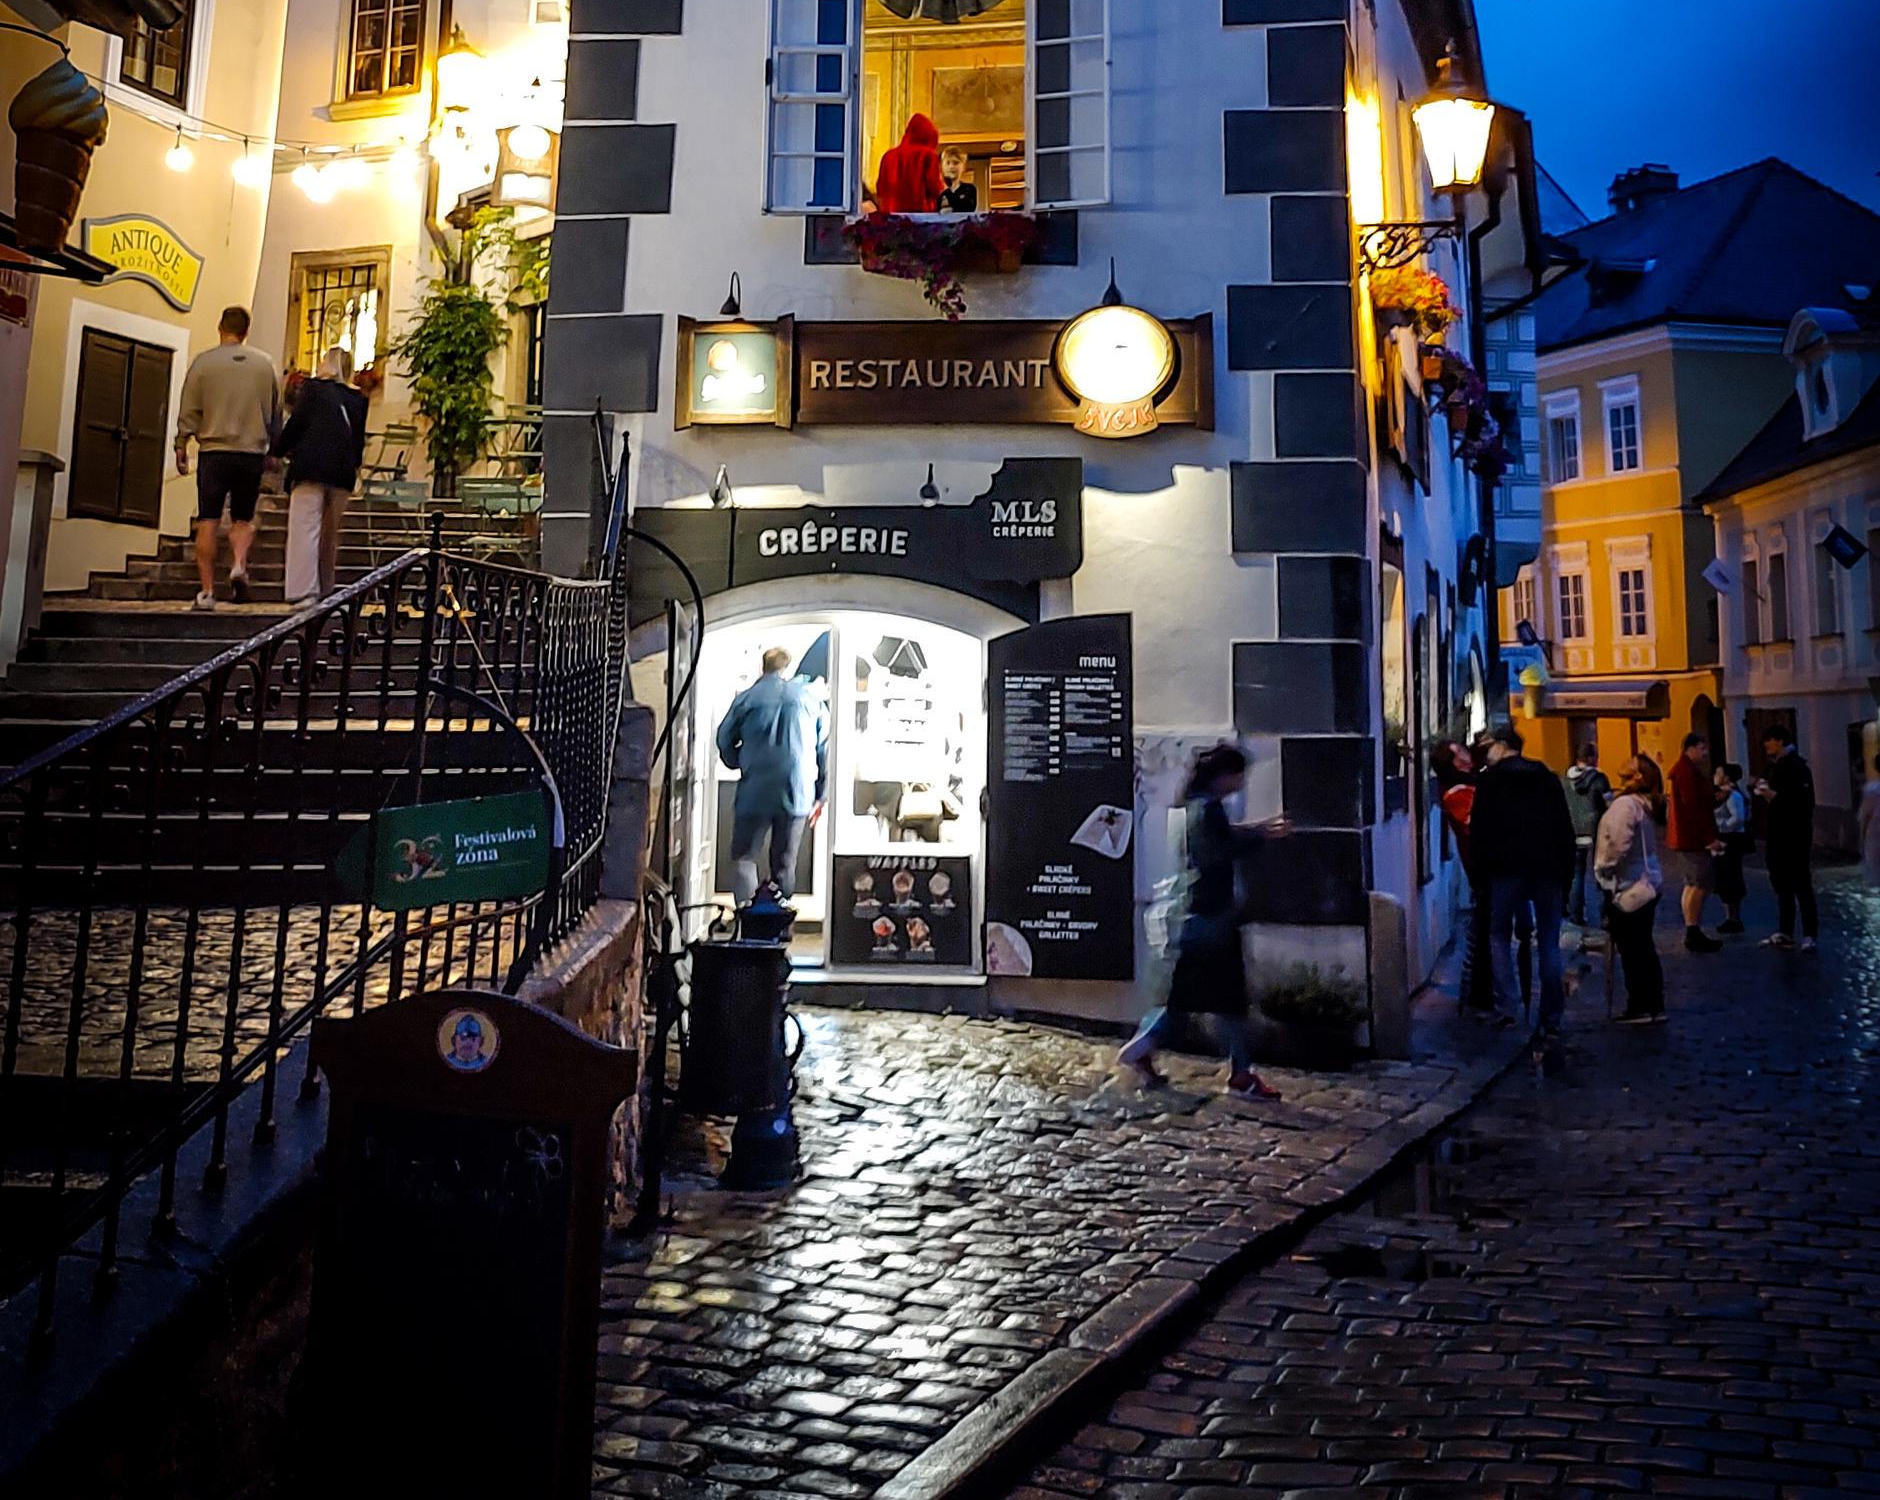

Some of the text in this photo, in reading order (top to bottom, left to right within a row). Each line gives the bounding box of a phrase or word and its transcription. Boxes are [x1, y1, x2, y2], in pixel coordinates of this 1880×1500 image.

[111, 229, 183, 275] ANTIQUE
[810, 358, 1050, 389] RESTAURANT
[991, 500, 1056, 523] MLS
[759, 520, 909, 556] CRÊPERIE
[993, 524, 1055, 538] CRÊPERIE
[1079, 656, 1116, 668] menu
[455, 823, 537, 848] Festivalová
[456, 846, 499, 865] zóna
